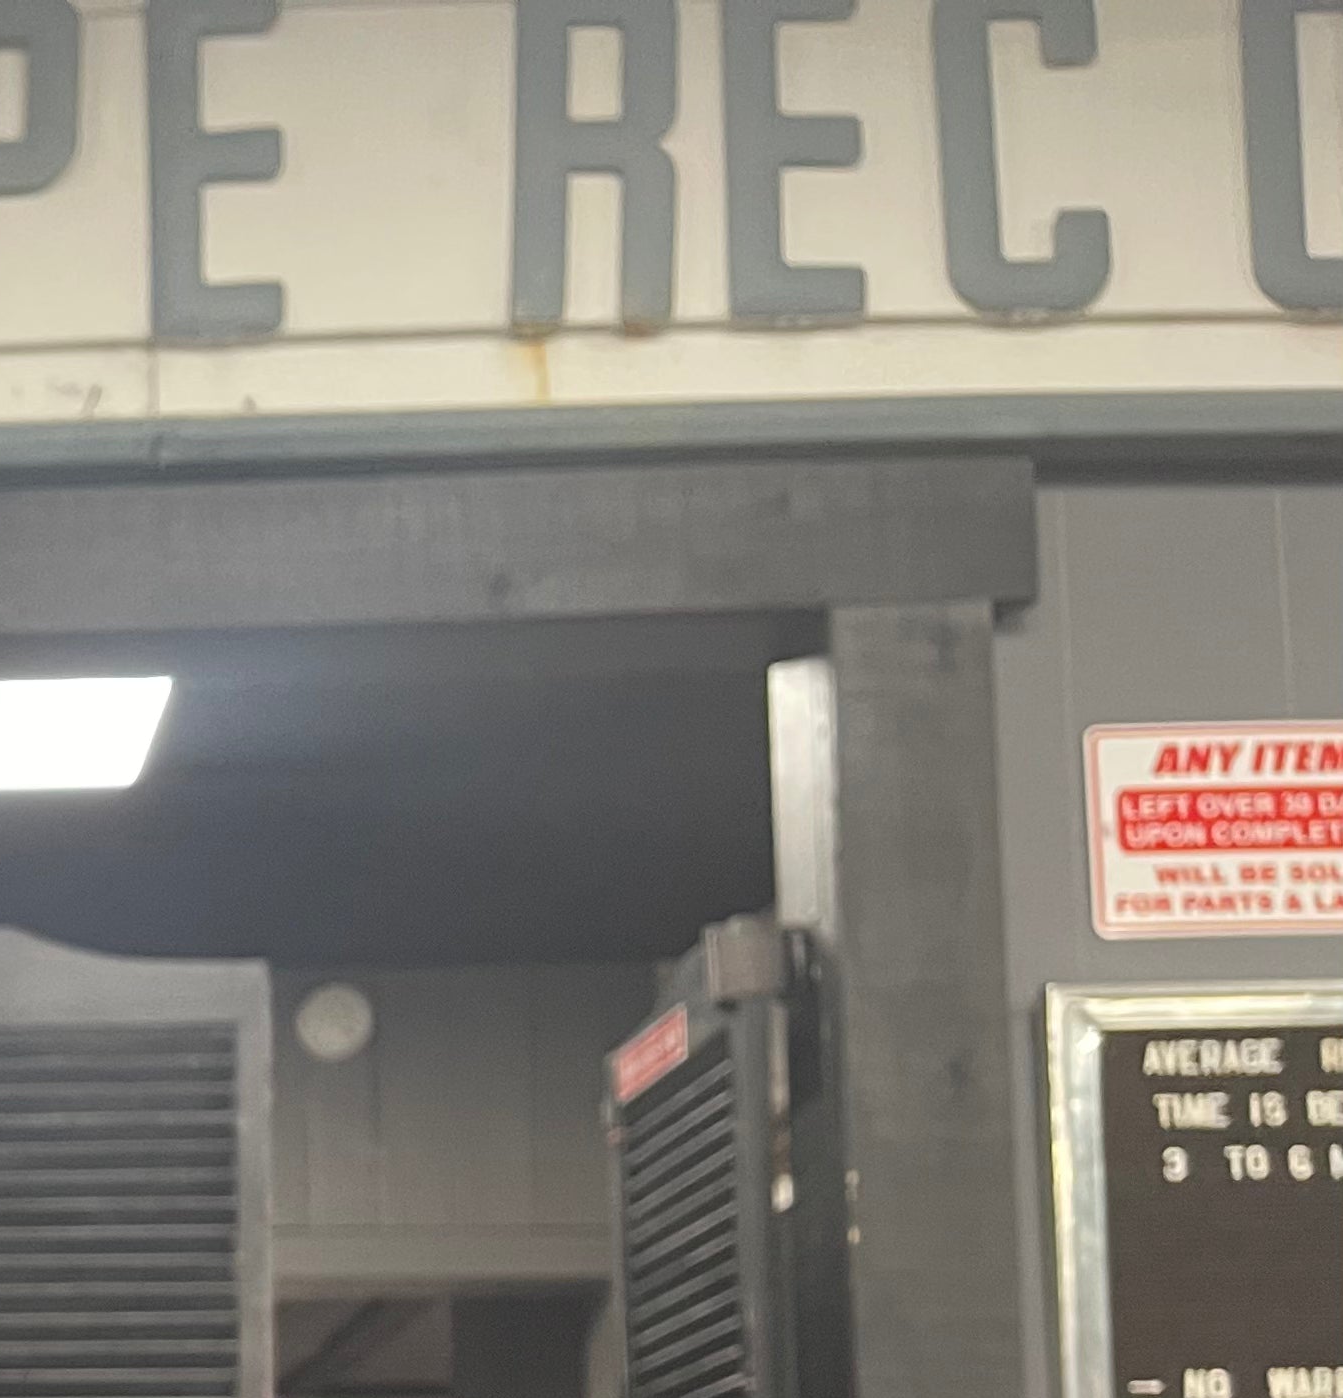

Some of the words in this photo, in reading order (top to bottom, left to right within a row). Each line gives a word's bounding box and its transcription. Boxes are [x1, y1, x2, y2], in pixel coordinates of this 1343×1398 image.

[1152, 742, 1241, 777] ANY
[1120, 792, 1190, 821] LEFT
[1195, 791, 1277, 820] OVER
[1124, 821, 1208, 849] UPON
[1142, 1037, 1285, 1077] AVERAGE
[1151, 1091, 1232, 1130] TIME
[1248, 1090, 1289, 1128] IS
[1222, 1143, 1271, 1182] TO
